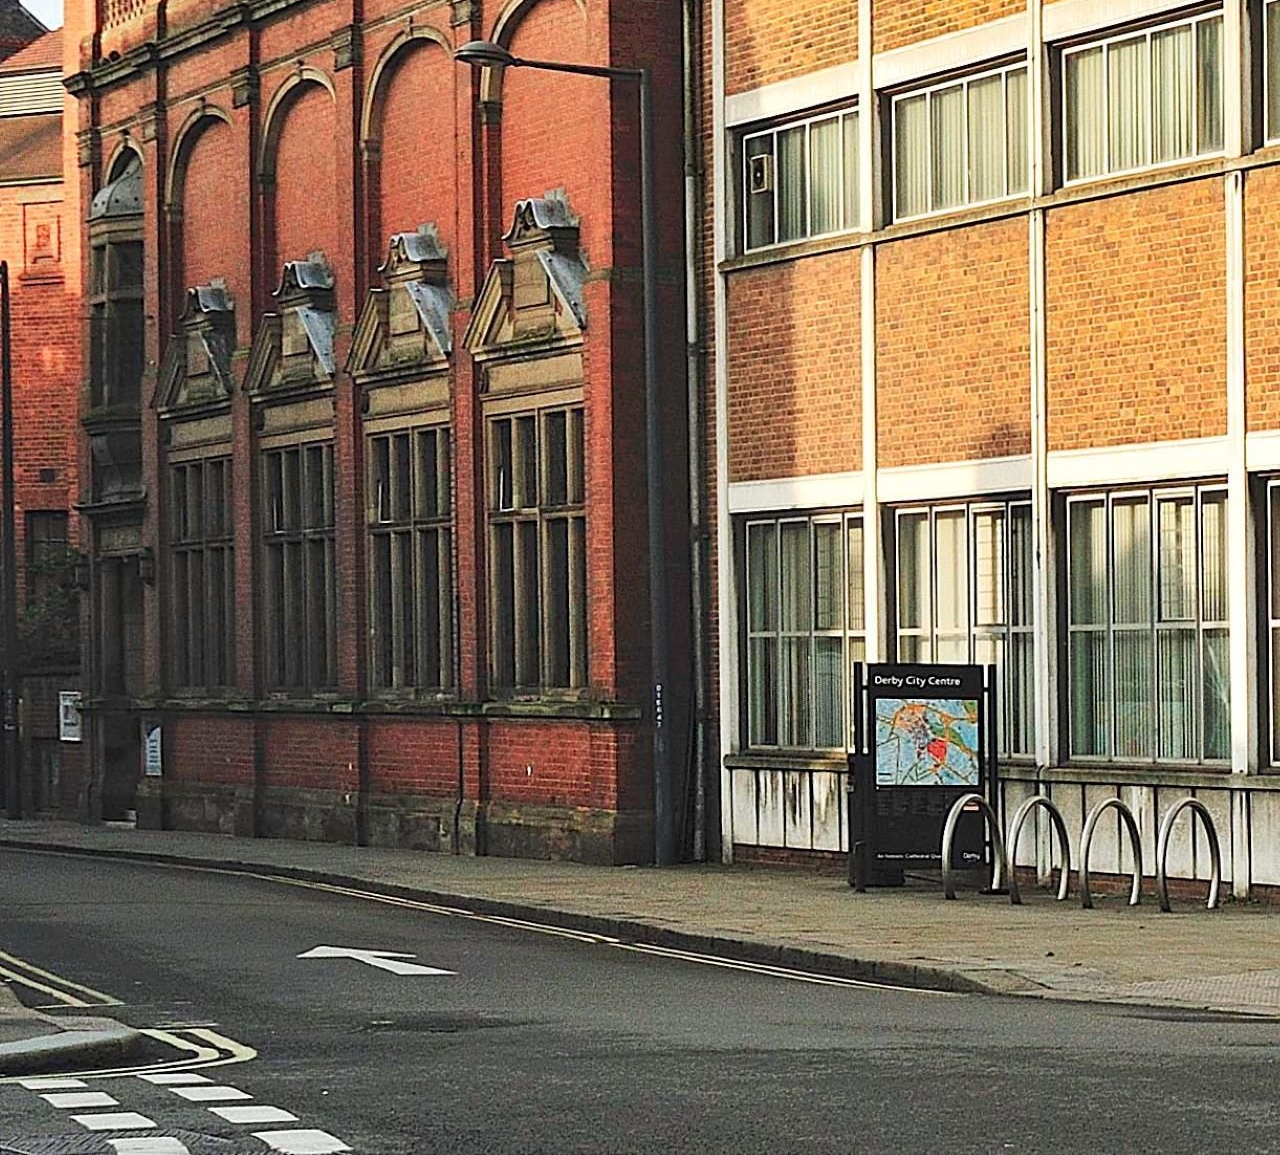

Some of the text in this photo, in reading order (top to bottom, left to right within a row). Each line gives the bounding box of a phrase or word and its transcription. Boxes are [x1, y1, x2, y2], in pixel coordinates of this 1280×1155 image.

[875, 676, 961, 687] Derby City Centre
